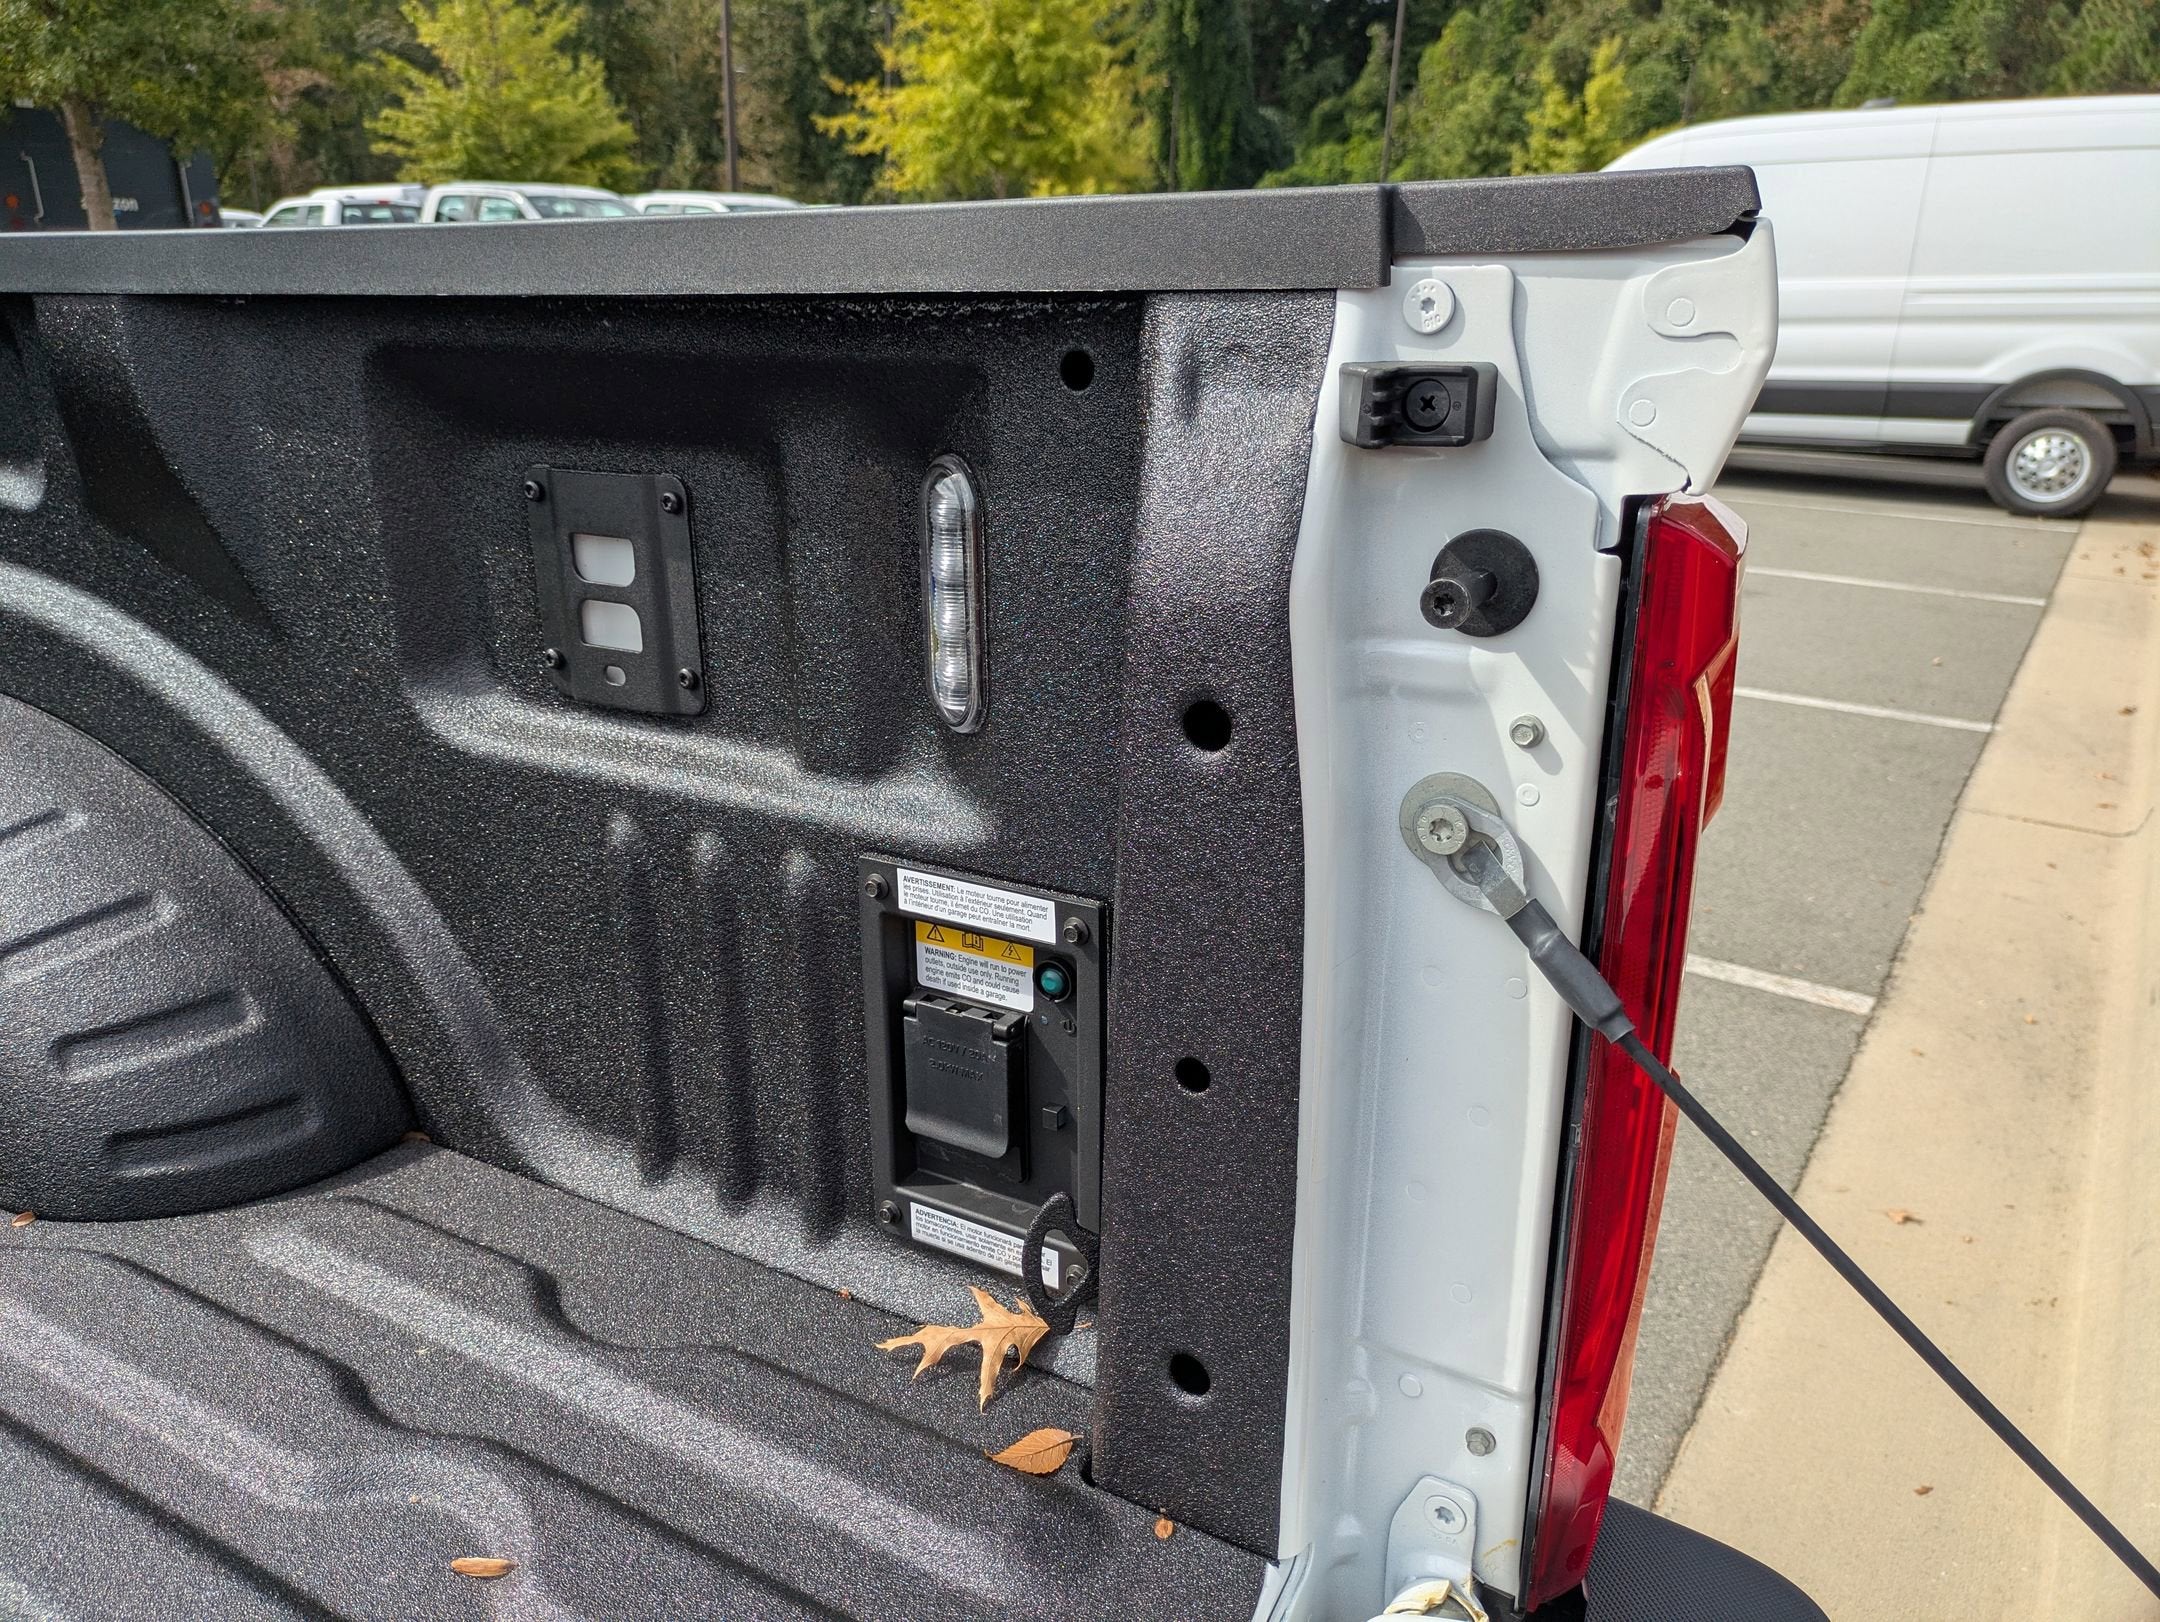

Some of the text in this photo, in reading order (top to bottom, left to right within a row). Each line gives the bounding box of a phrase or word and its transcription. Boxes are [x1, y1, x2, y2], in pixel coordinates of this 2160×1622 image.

[903, 875, 955, 892] AVERTISSEMENT:
[957, 887, 964, 895] Le
[966, 889, 984, 899] moteur
[987, 894, 1005, 903] tourne
[1021, 901, 1048, 913] alimenter
[910, 893, 928, 901] moteur
[930, 897, 949, 906] tourne,
[979, 907, 990, 915] CO.
[992, 910, 1004, 918] Une
[1006, 914, 1032, 924] utilisation
[932, 889, 958, 900] Utilisation
[1027, 910, 1047, 920] Quand
[935, 905, 946, 913] d'un
[948, 909, 967, 918] garage
[1016, 924, 1031, 932] mort.
[925, 946, 956, 961] WARNING:
[958, 954, 978, 966] Engine
[979, 961, 988, 969] will
[990, 963, 1000, 971] run
[1008, 968, 1026, 978] power
[946, 962, 966, 972] outside
[995, 972, 1019, 987] Running
[925, 966, 1019, 995] engine emits CO and could cause
[926, 974, 941, 984] death
[948, 981, 961, 989] used
[962, 983, 979, 993] inside
[986, 990, 1007, 1001] garage.
[916, 1208, 959, 1227] ADVERTENCIA:
[967, 1226, 982, 1236] motor
[916, 1222, 930, 1231] motor
[997, 1248, 1006, 1257] CO
